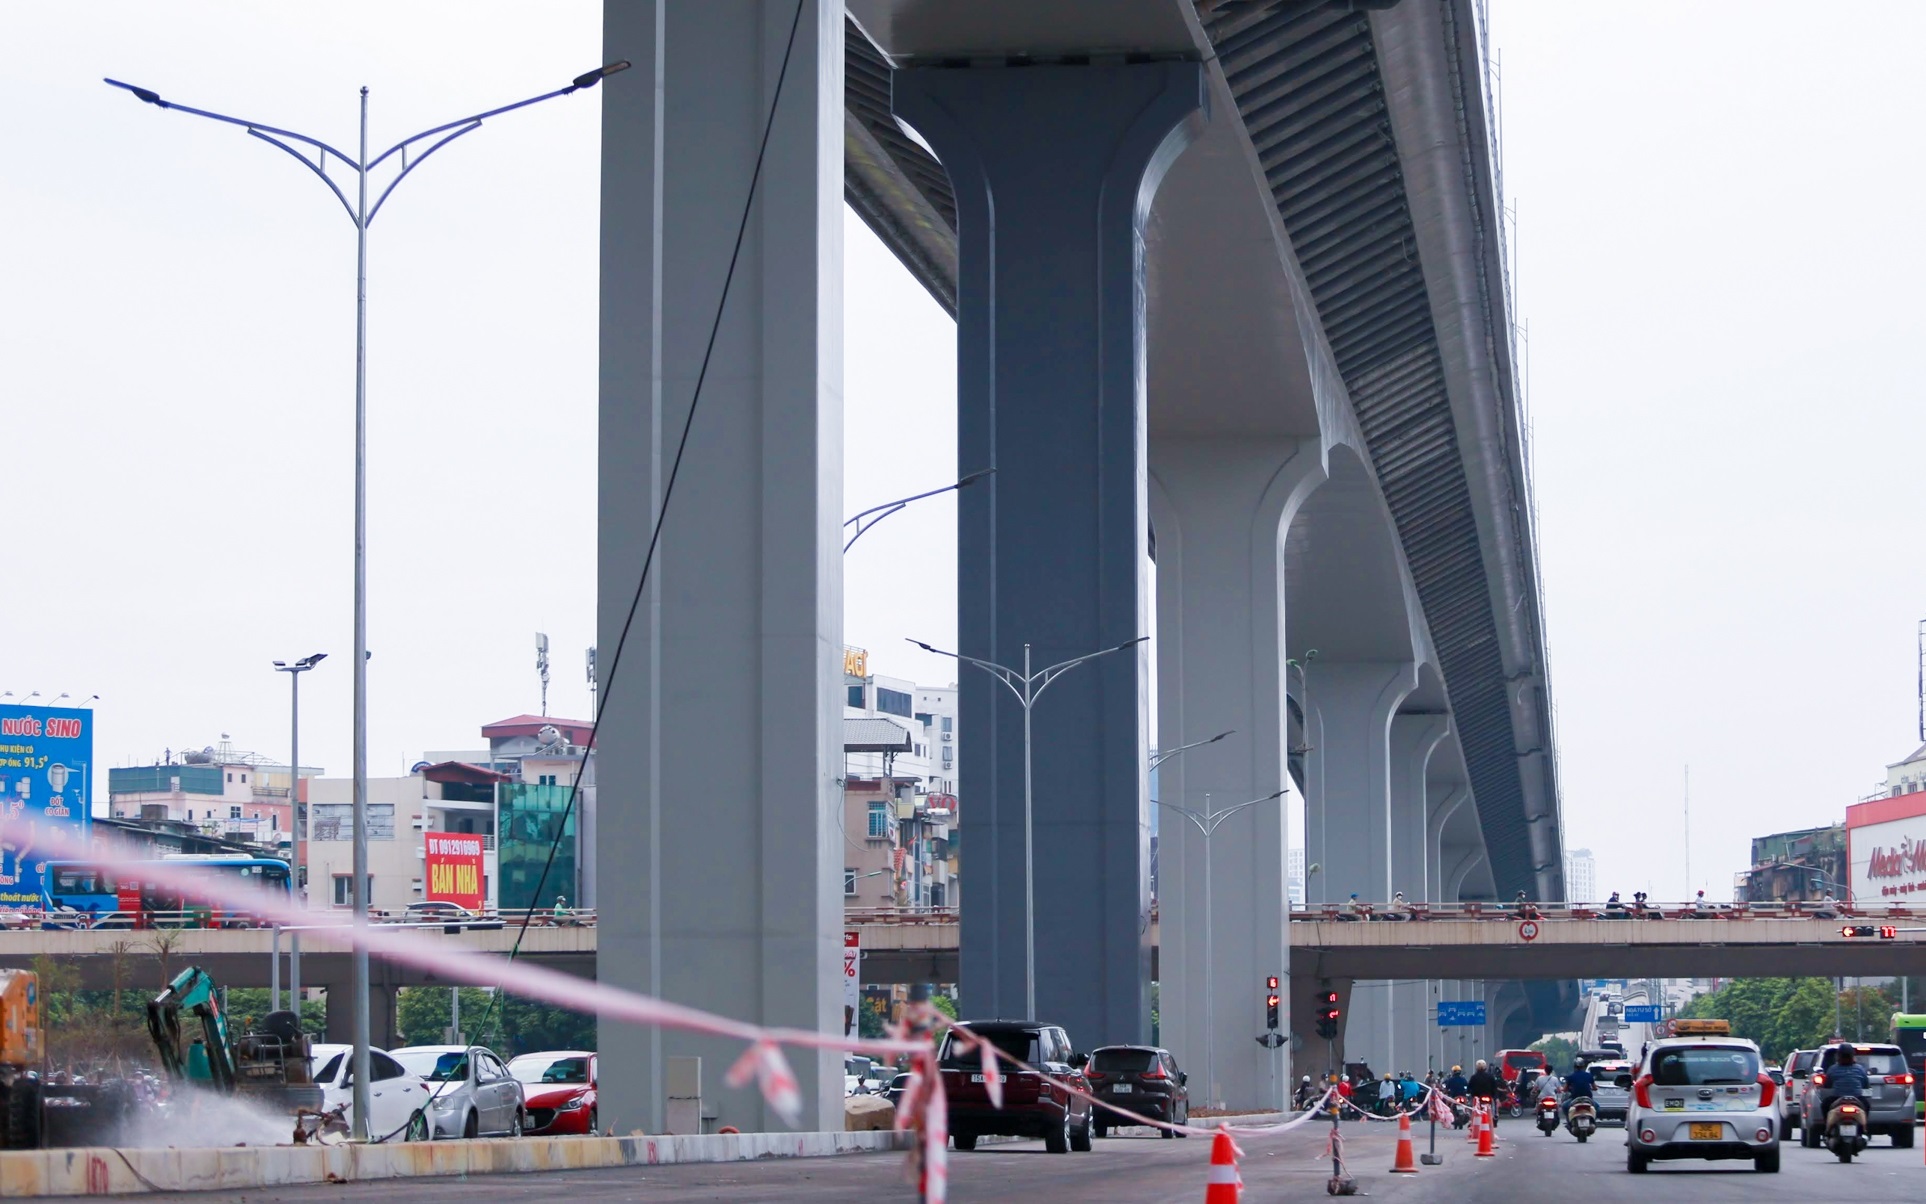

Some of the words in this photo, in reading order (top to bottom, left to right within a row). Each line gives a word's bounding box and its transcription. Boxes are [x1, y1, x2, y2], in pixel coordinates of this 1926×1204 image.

[2, 715, 41, 736] NƯỚC
[45, 717, 81, 739] SINO
[432, 857, 453, 893] BÁN
[456, 858, 479, 894] NHÀ
